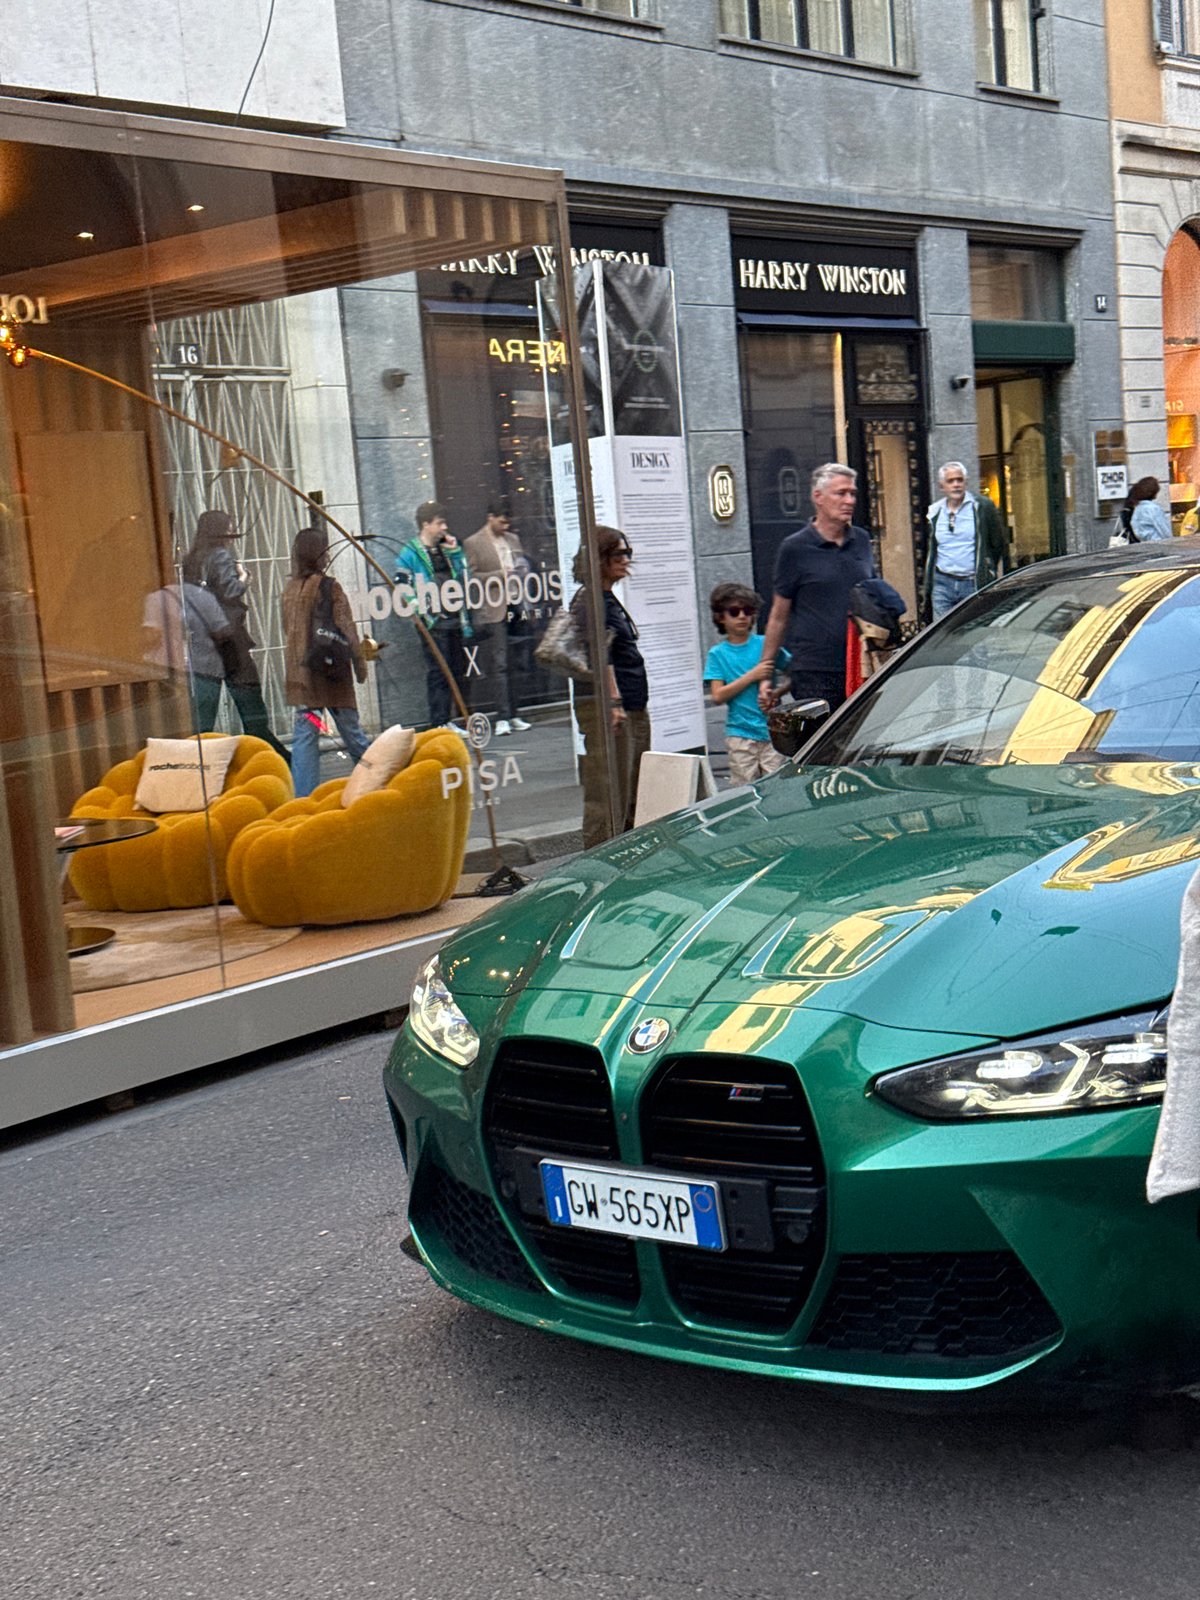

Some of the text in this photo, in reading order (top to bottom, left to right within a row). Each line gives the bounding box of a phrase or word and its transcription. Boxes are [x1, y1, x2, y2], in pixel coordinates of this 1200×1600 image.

[738, 258, 907, 296] HARRY WINSTON
[178, 344, 199, 365] 16
[507, 605, 563, 622] PARI
[463, 645, 481, 677] X
[440, 755, 524, 800] PISA
[567, 1179, 691, 1234] GW 565XP
